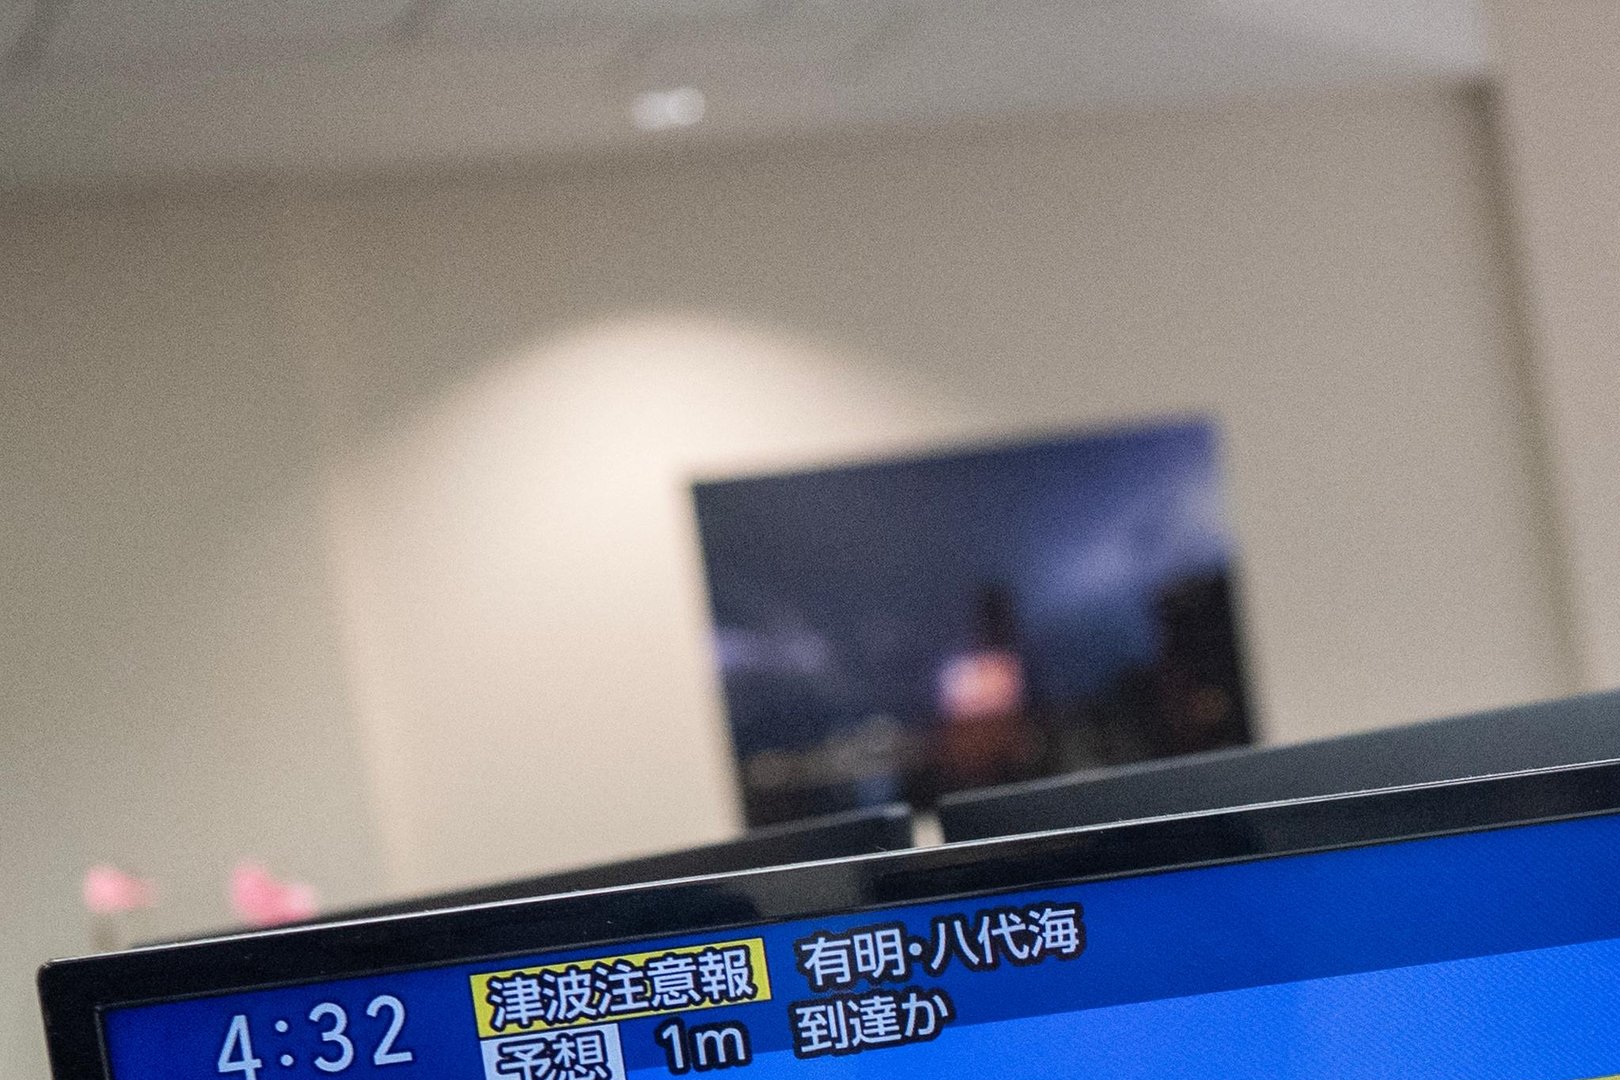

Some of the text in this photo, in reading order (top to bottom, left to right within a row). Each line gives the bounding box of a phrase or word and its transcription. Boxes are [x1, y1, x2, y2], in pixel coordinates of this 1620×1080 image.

[489, 948, 753, 1027] 津波注意報
[660, 1023, 747, 1070] 1m
[796, 998, 949, 1053] 到達か
